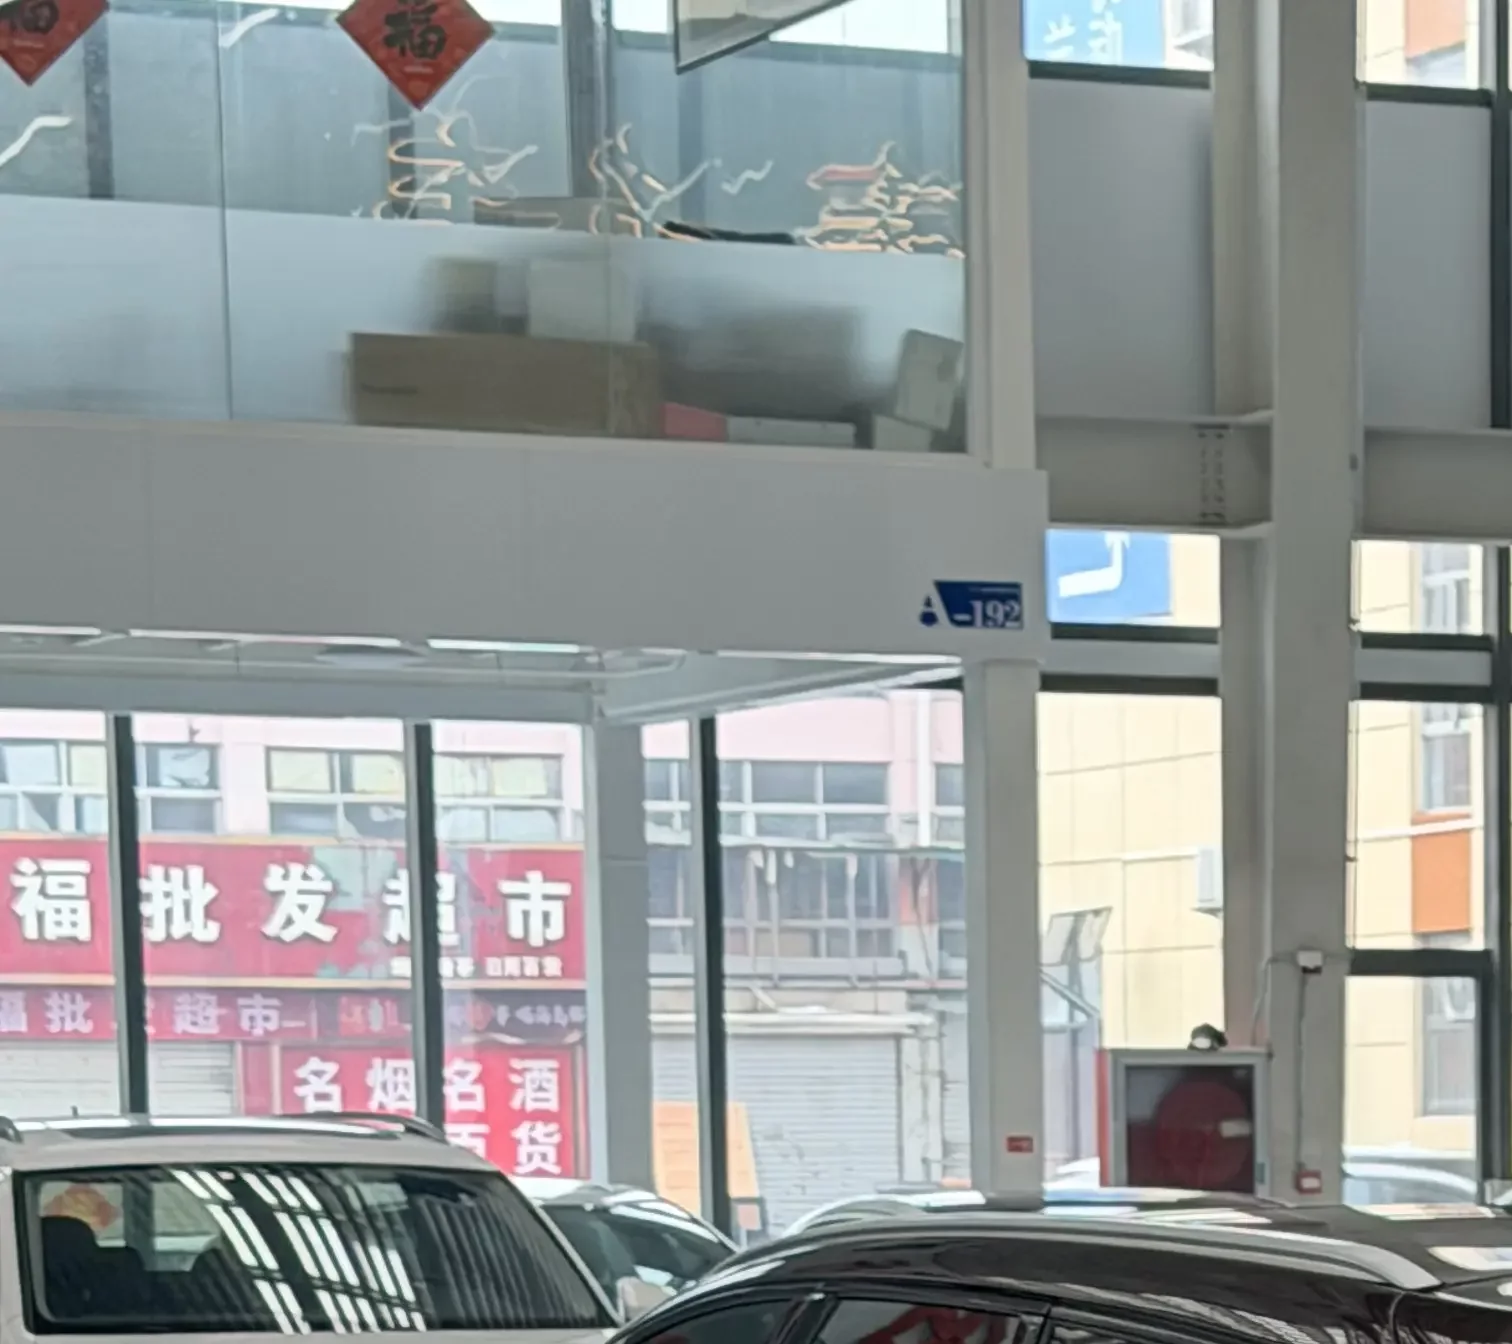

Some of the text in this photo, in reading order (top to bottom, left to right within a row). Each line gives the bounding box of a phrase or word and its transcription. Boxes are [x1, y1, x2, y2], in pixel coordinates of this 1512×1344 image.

[10, 857, 572, 948] 福批发超市
[293, 1056, 560, 1113] 名烟名酒
